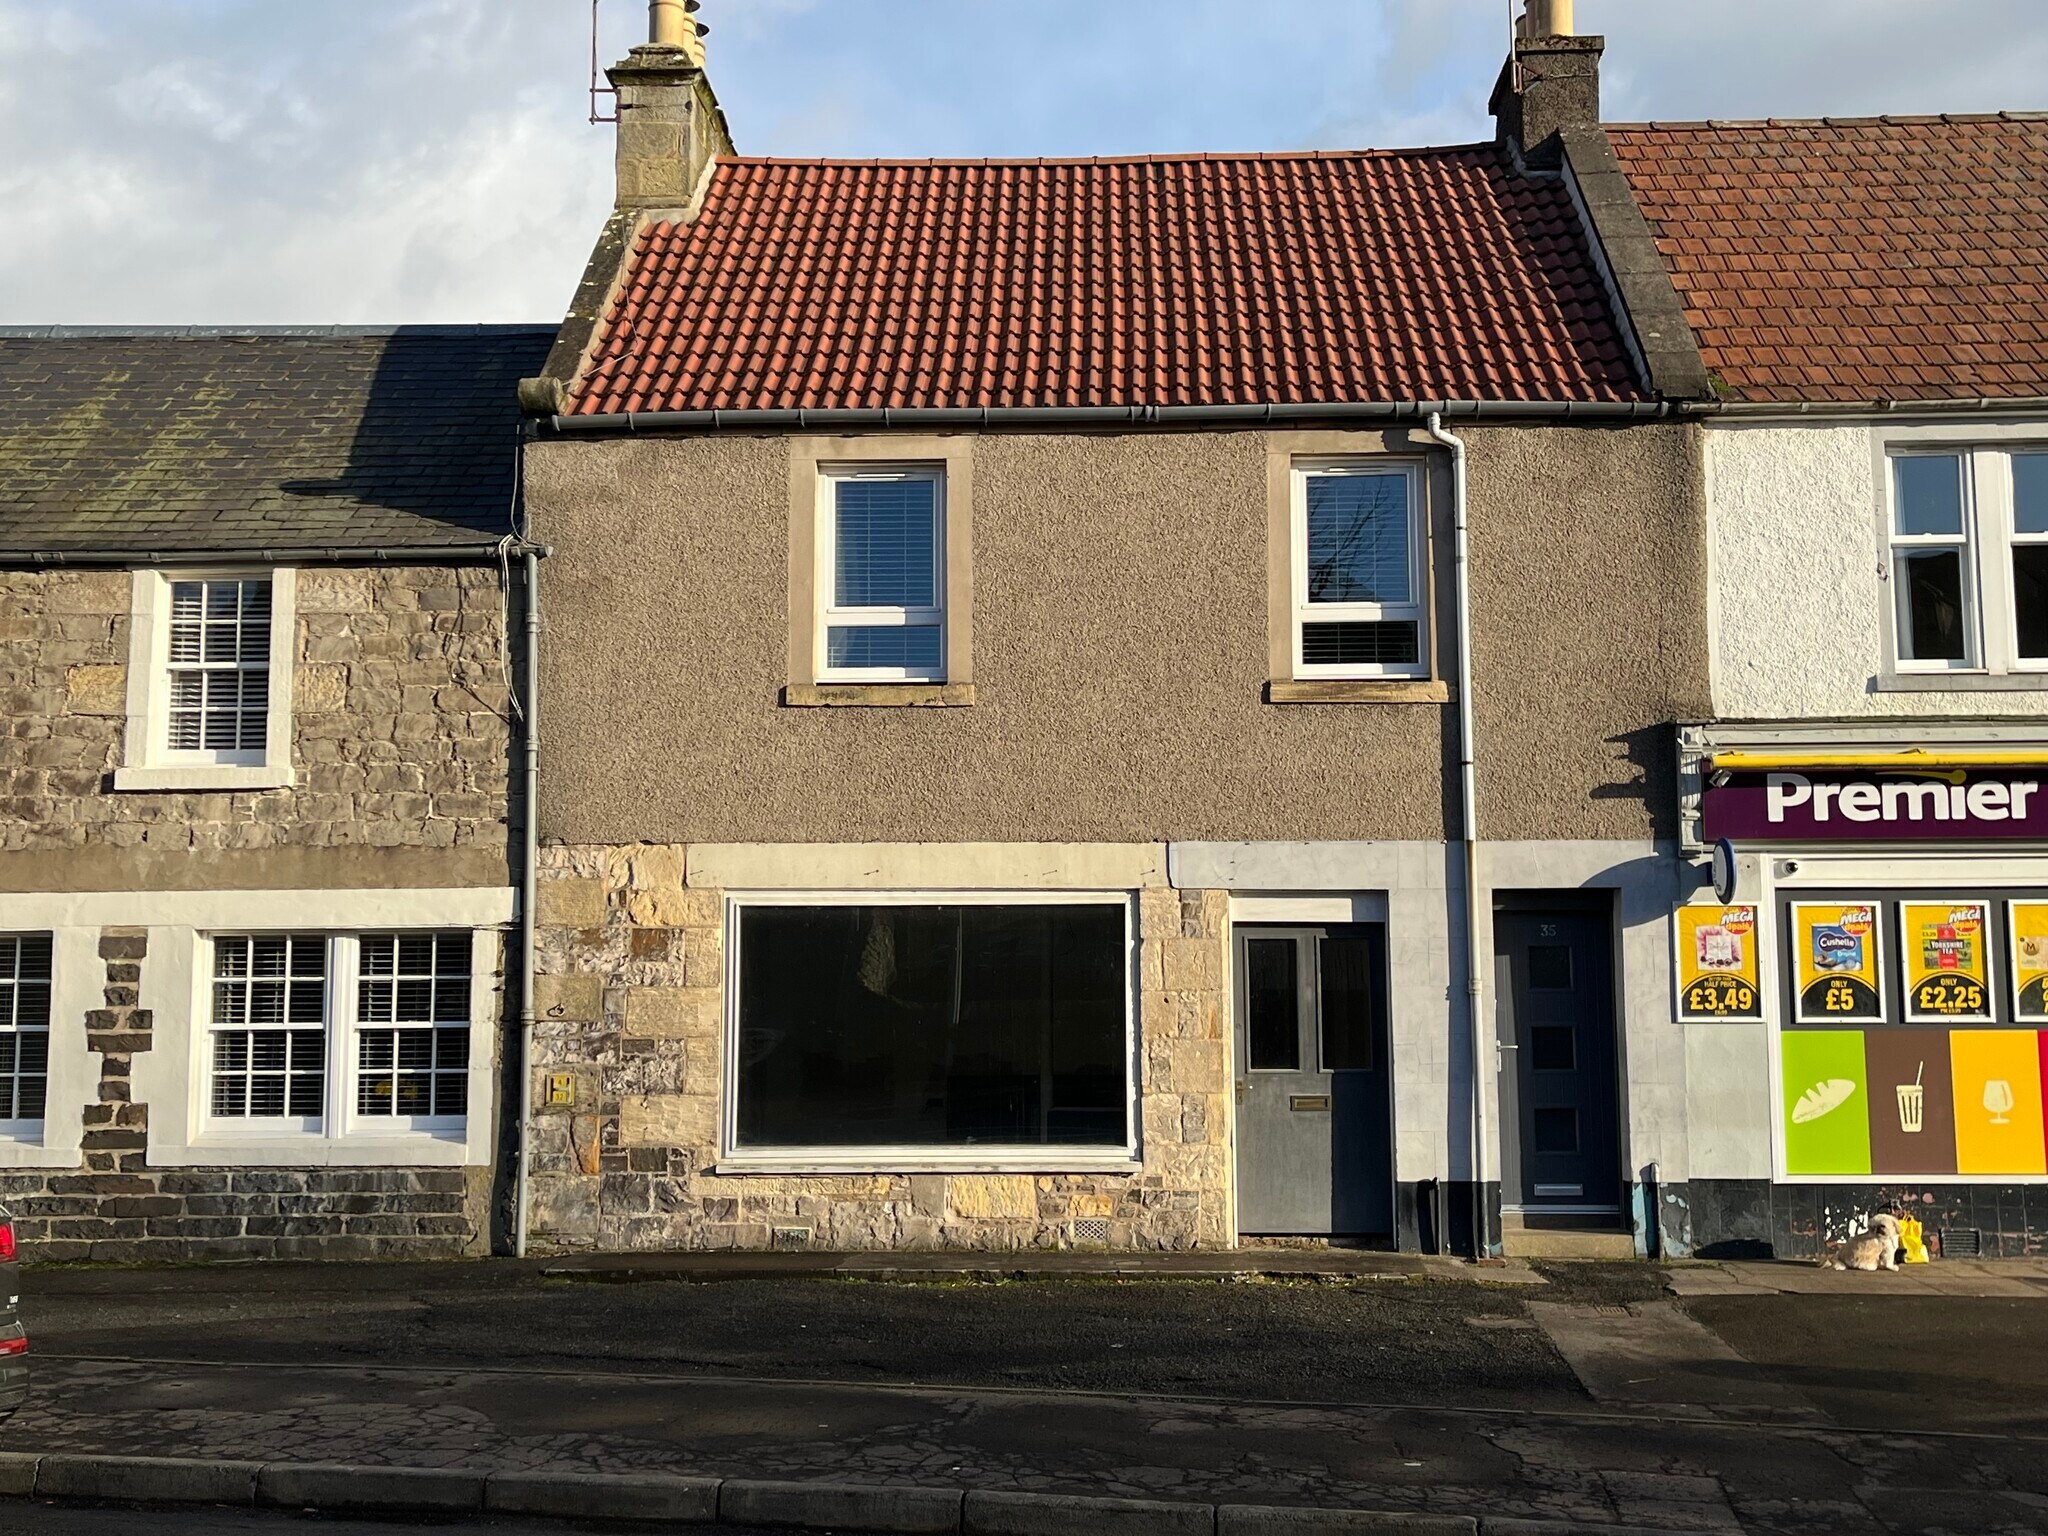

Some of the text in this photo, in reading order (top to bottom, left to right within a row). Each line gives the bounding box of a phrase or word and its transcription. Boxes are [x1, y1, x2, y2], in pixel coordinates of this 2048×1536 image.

[1766, 769, 2038, 822] Premier
[1720, 911, 1753, 925] MEGA
[1840, 911, 1871, 926] MEGA
[1948, 908, 1981, 923] MEGA
[1540, 924, 1557, 937] 35
[1820, 937, 1855, 948] Cushelle
[1930, 941, 1964, 949] YORKSHIRE
[1704, 980, 1737, 988] HALF PRICE
[1830, 980, 1848, 988] ONLY
[1940, 978, 1958, 986] ONLY
[1689, 987, 1753, 1011] £3.49
[1825, 988, 1855, 1011] £5
[1919, 986, 1982, 1009] £2.25
